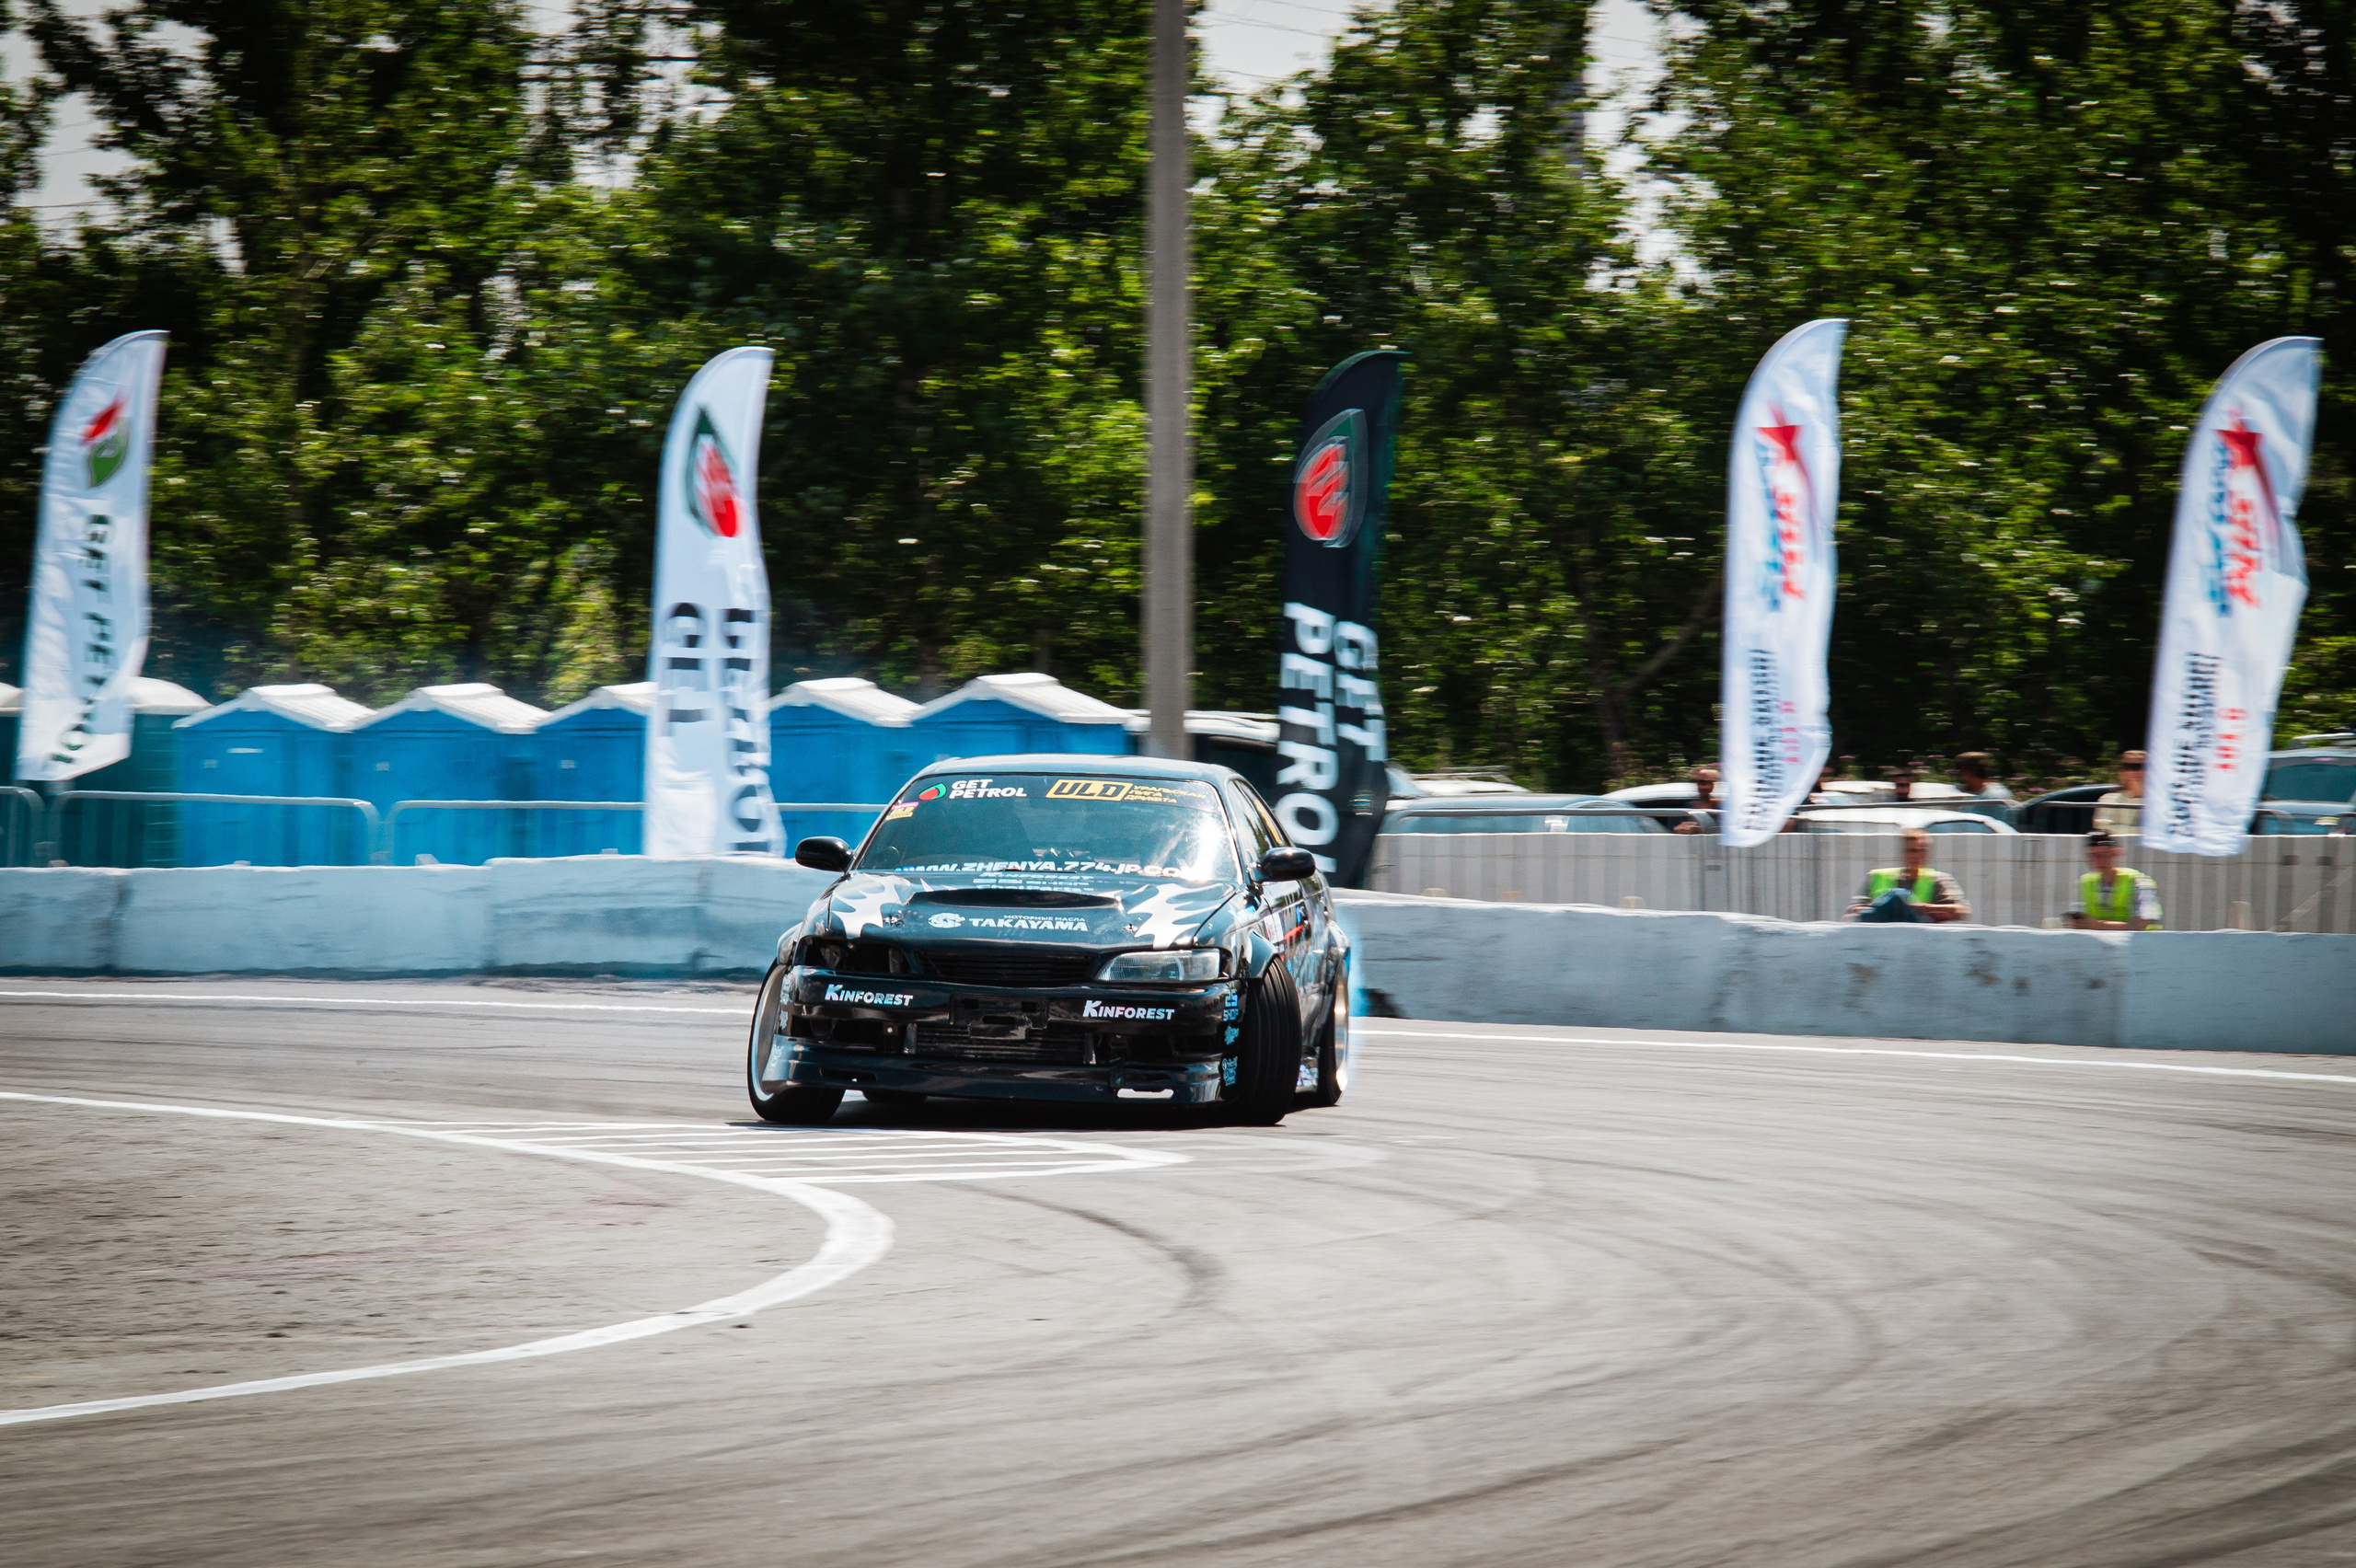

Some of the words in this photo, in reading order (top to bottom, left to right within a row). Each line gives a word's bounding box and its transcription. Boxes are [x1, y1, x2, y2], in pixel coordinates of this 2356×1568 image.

[1334, 620, 1388, 761] GET
[952, 778, 993, 790] GET
[949, 788, 1027, 799] PETROL
[968, 918, 1089, 932] TAKAYAMA
